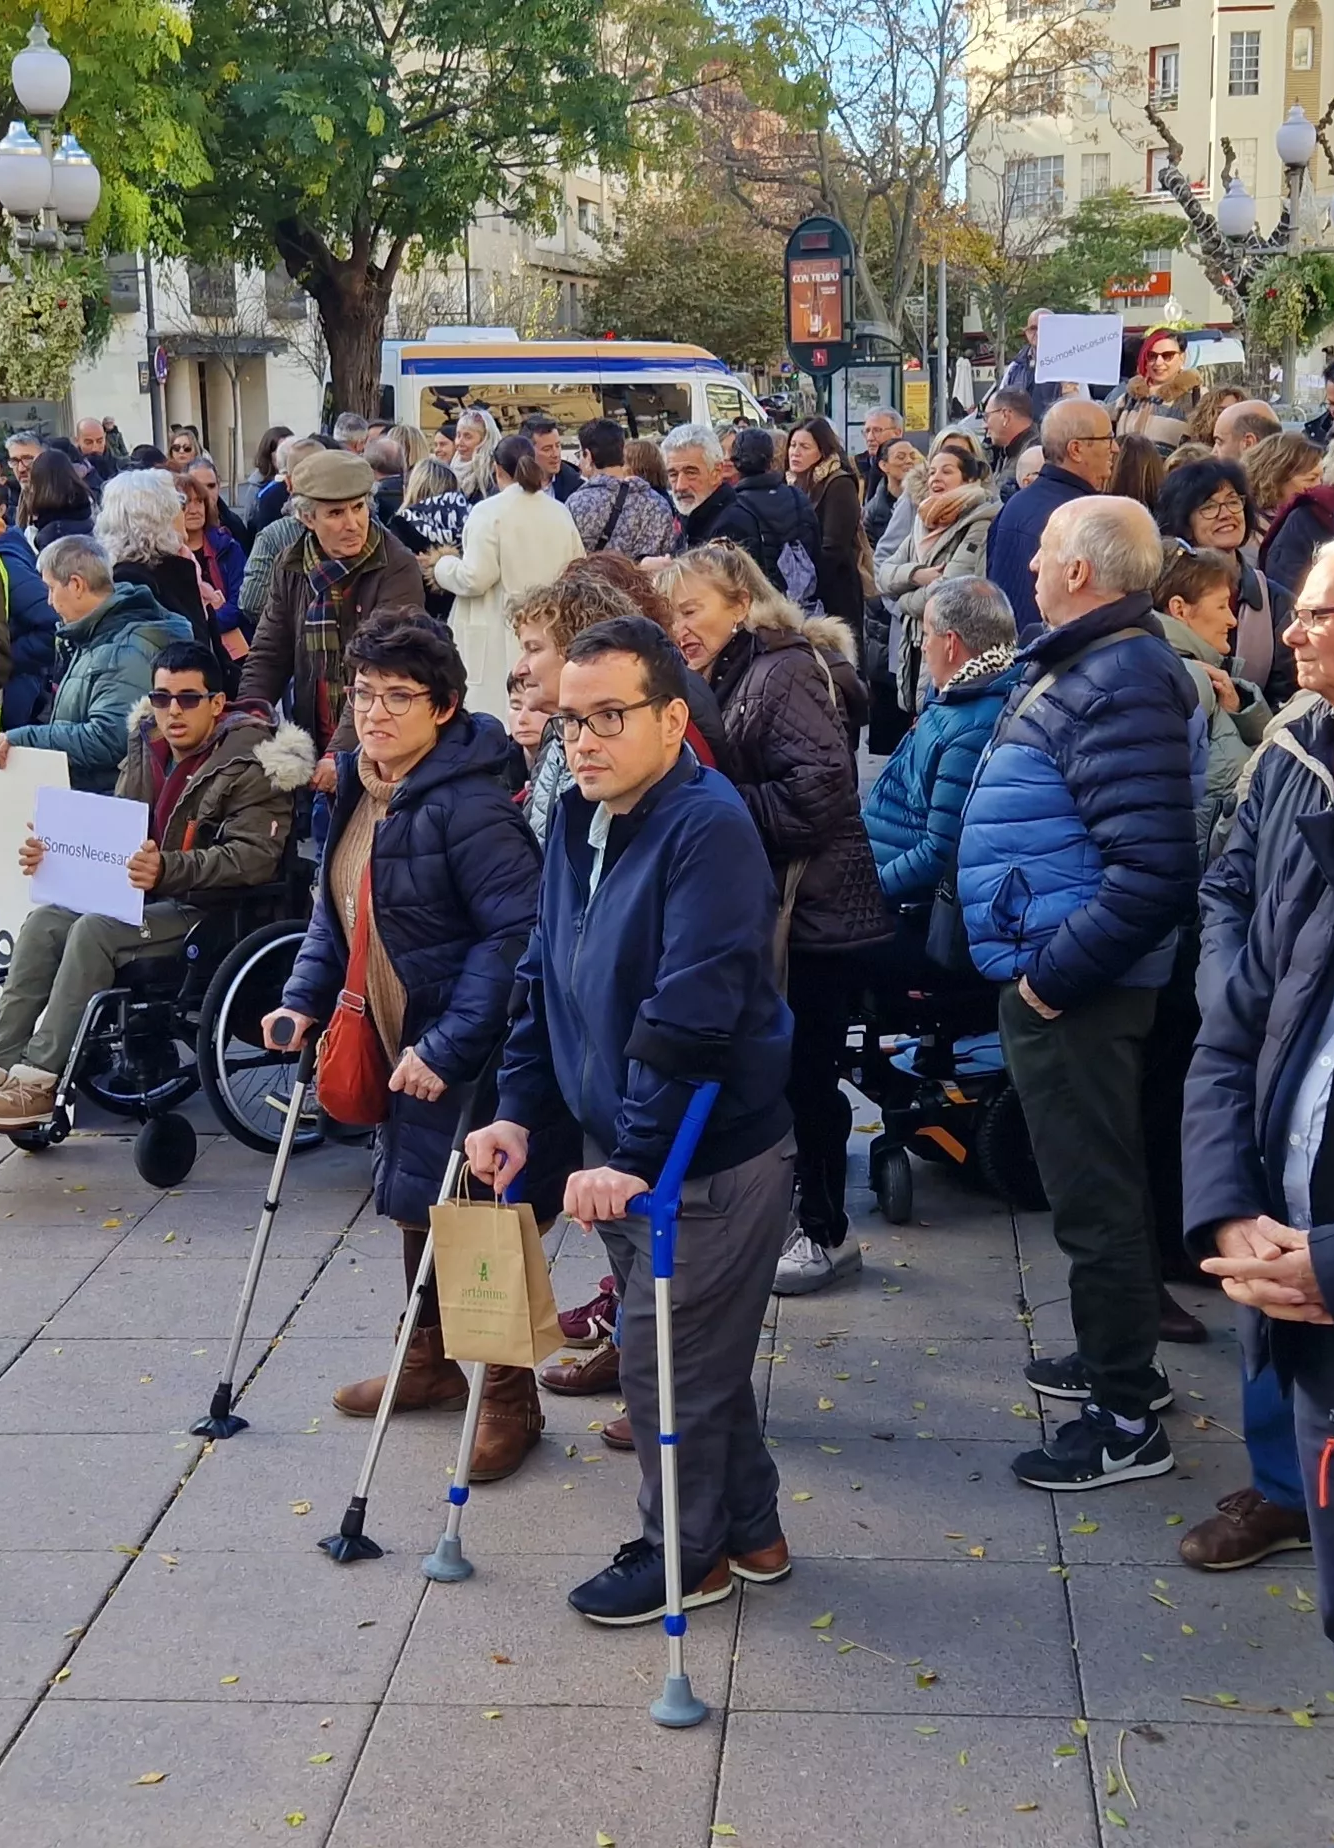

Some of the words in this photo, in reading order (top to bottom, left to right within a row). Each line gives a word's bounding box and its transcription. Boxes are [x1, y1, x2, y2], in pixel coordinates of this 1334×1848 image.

[793, 275, 809, 283] CON
[811, 273, 839, 282] TIEMPO
[1039, 331, 1120, 367] #SomosNecesarios
